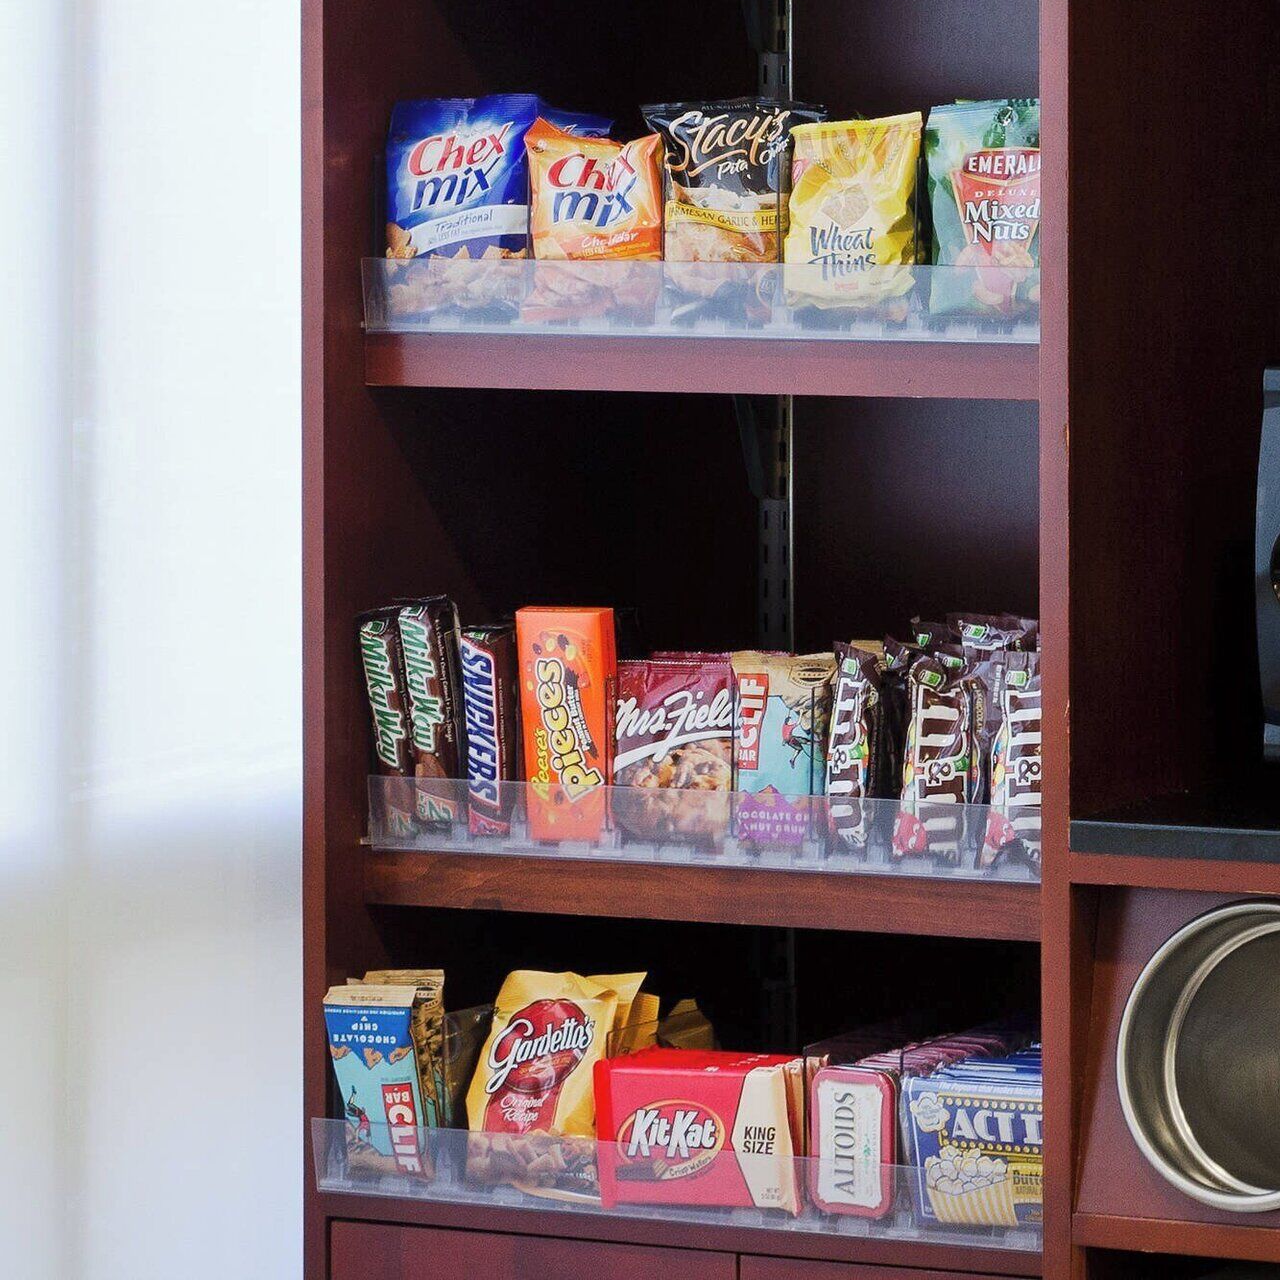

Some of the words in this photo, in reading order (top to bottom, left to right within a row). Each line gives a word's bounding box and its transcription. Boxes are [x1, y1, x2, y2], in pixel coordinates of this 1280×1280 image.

[408, 121, 515, 177] Chex
[665, 108, 791, 171] Stacy's
[718, 161, 748, 180] Pita
[968, 155, 1040, 176] EMERAL
[435, 211, 493, 233] Traditional
[964, 201, 1038, 224] Mixed
[971, 220, 1029, 243] Nuts
[810, 225, 873, 256] Wheat
[807, 253, 876, 280] Thins
[361, 633, 395, 710] Milky
[399, 618, 434, 702] Milky
[411, 692, 444, 752] Way
[462, 644, 499, 803] SNICKERS
[536, 658, 604, 801] Pieces
[616, 695, 672, 740] Mrs.
[740, 678, 765, 748] CLIF
[373, 706, 405, 767] Way
[738, 750, 757, 761] BAR
[531, 728, 548, 799] Reese's
[333, 1034, 397, 1044] CHOCOLATE
[352, 1023, 378, 1031] CHIP
[486, 1015, 596, 1093] Gardetto's
[384, 1091, 410, 1102] BAR
[388, 1106, 421, 1171] CLIF
[744, 1126, 775, 1140] KING
[834, 1092, 855, 1196] ALTOIDS
[952, 1109, 1014, 1143] ACT
[743, 1141, 774, 1155] SIZE
